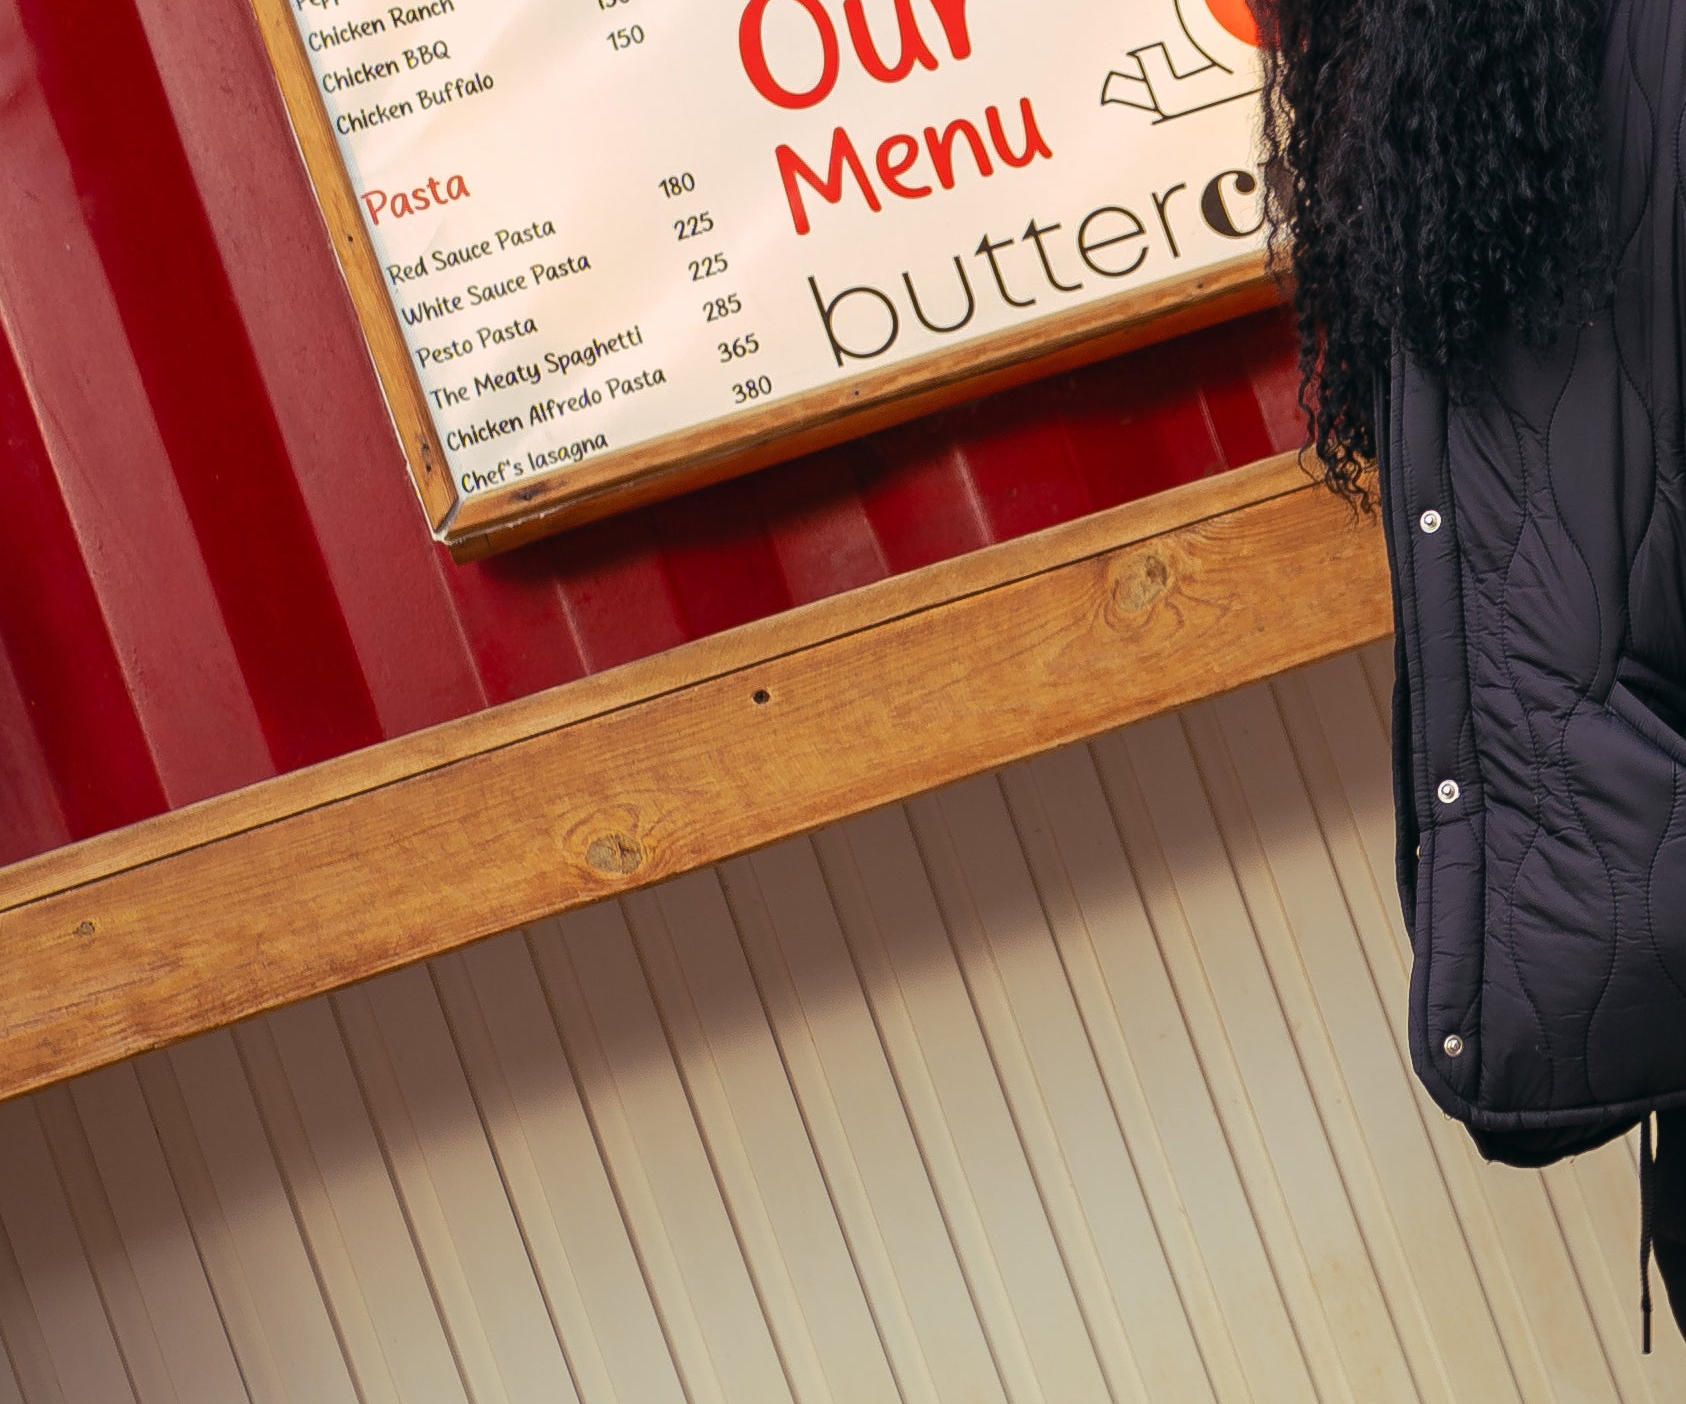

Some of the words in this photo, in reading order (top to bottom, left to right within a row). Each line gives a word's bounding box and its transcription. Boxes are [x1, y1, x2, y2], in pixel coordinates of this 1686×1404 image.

[307, 19, 387, 53] Chicken
[322, 61, 401, 95] Chicken
[402, 40, 451, 69] BBQ
[336, 101, 414, 136] Chicken
[416, 73, 493, 110] Buffalo
[607, 25, 645, 51] 150
[360, 174, 471, 226] Pasta
[775, 97, 1053, 236] Menu
[386, 255, 429, 285] Red
[432, 241, 492, 271] Sauce
[495, 221, 556, 250] Pasta
[659, 173, 695, 198] 180
[402, 296, 464, 325] White
[467, 275, 527, 305] Sauce
[530, 256, 591, 285] Pasta
[674, 211, 714, 241] 225
[807, 160, 1290, 368] butterc
[416, 339, 473, 368] Pesto
[476, 319, 538, 348] Pasta
[688, 252, 728, 281] 225
[430, 387, 470, 409] The
[474, 363, 541, 397] Meaty
[544, 325, 643, 375] Spaghetti
[703, 293, 741, 323] 285
[446, 415, 525, 452] Chicken
[530, 388, 602, 426] Alfredo
[605, 369, 666, 399] Pasta
[718, 333, 759, 363] 365
[460, 459, 524, 494] Chef's
[527, 433, 609, 472] lasagna
[732, 375, 773, 404] 380
